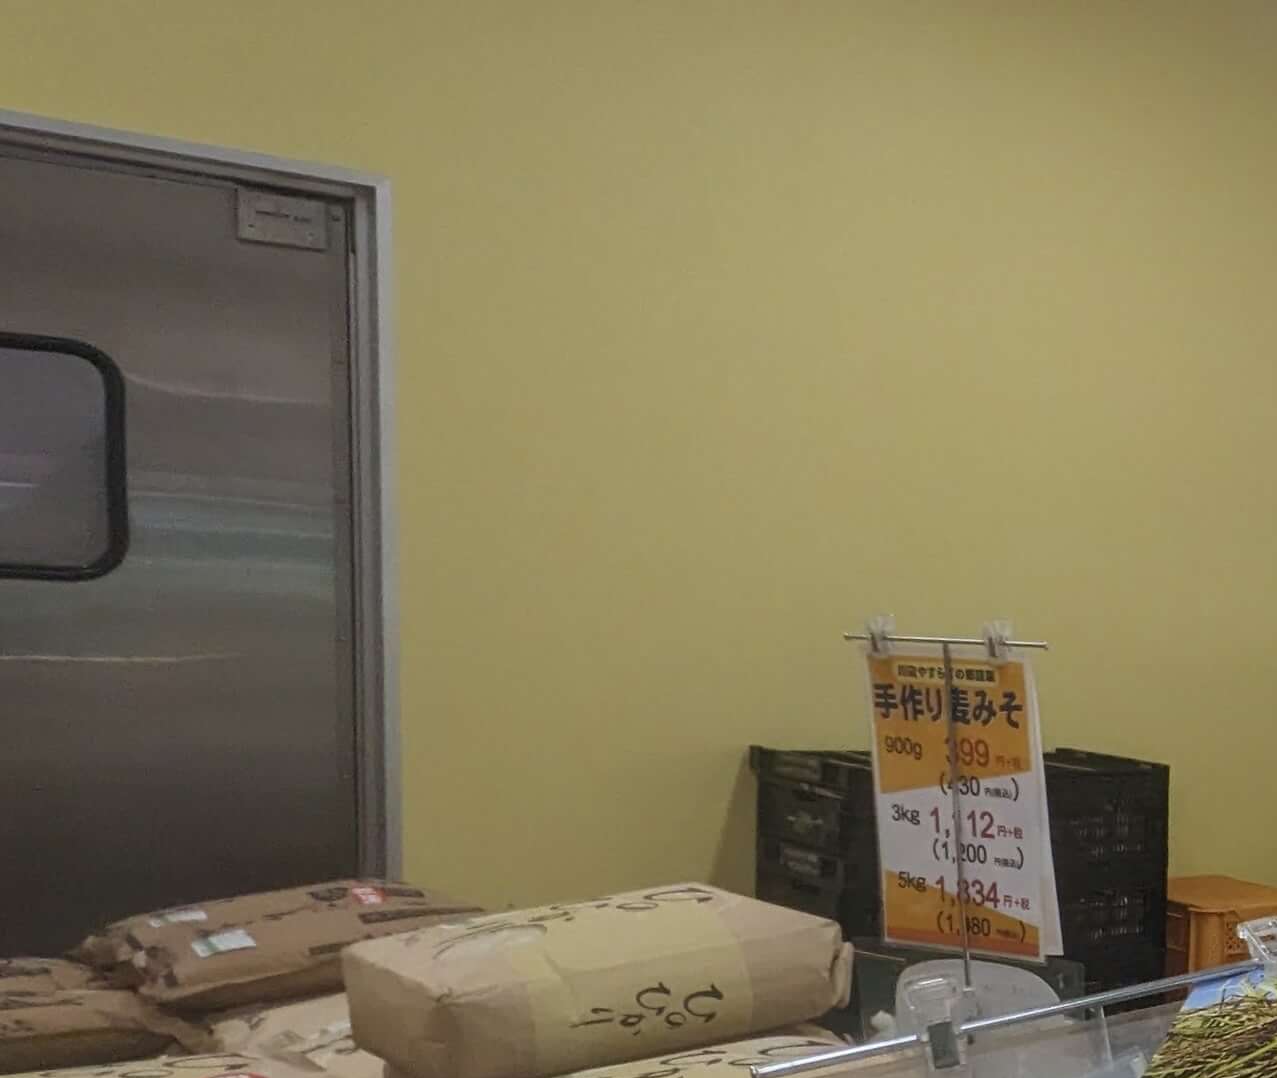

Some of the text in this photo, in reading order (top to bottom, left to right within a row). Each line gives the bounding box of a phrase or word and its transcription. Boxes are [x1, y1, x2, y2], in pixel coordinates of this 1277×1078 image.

[874, 683, 1023, 729] 手作り麦みそ
[884, 736, 922, 760] 900g
[892, 804, 920, 825] 3kg
[898, 871, 927, 892] 5kg
